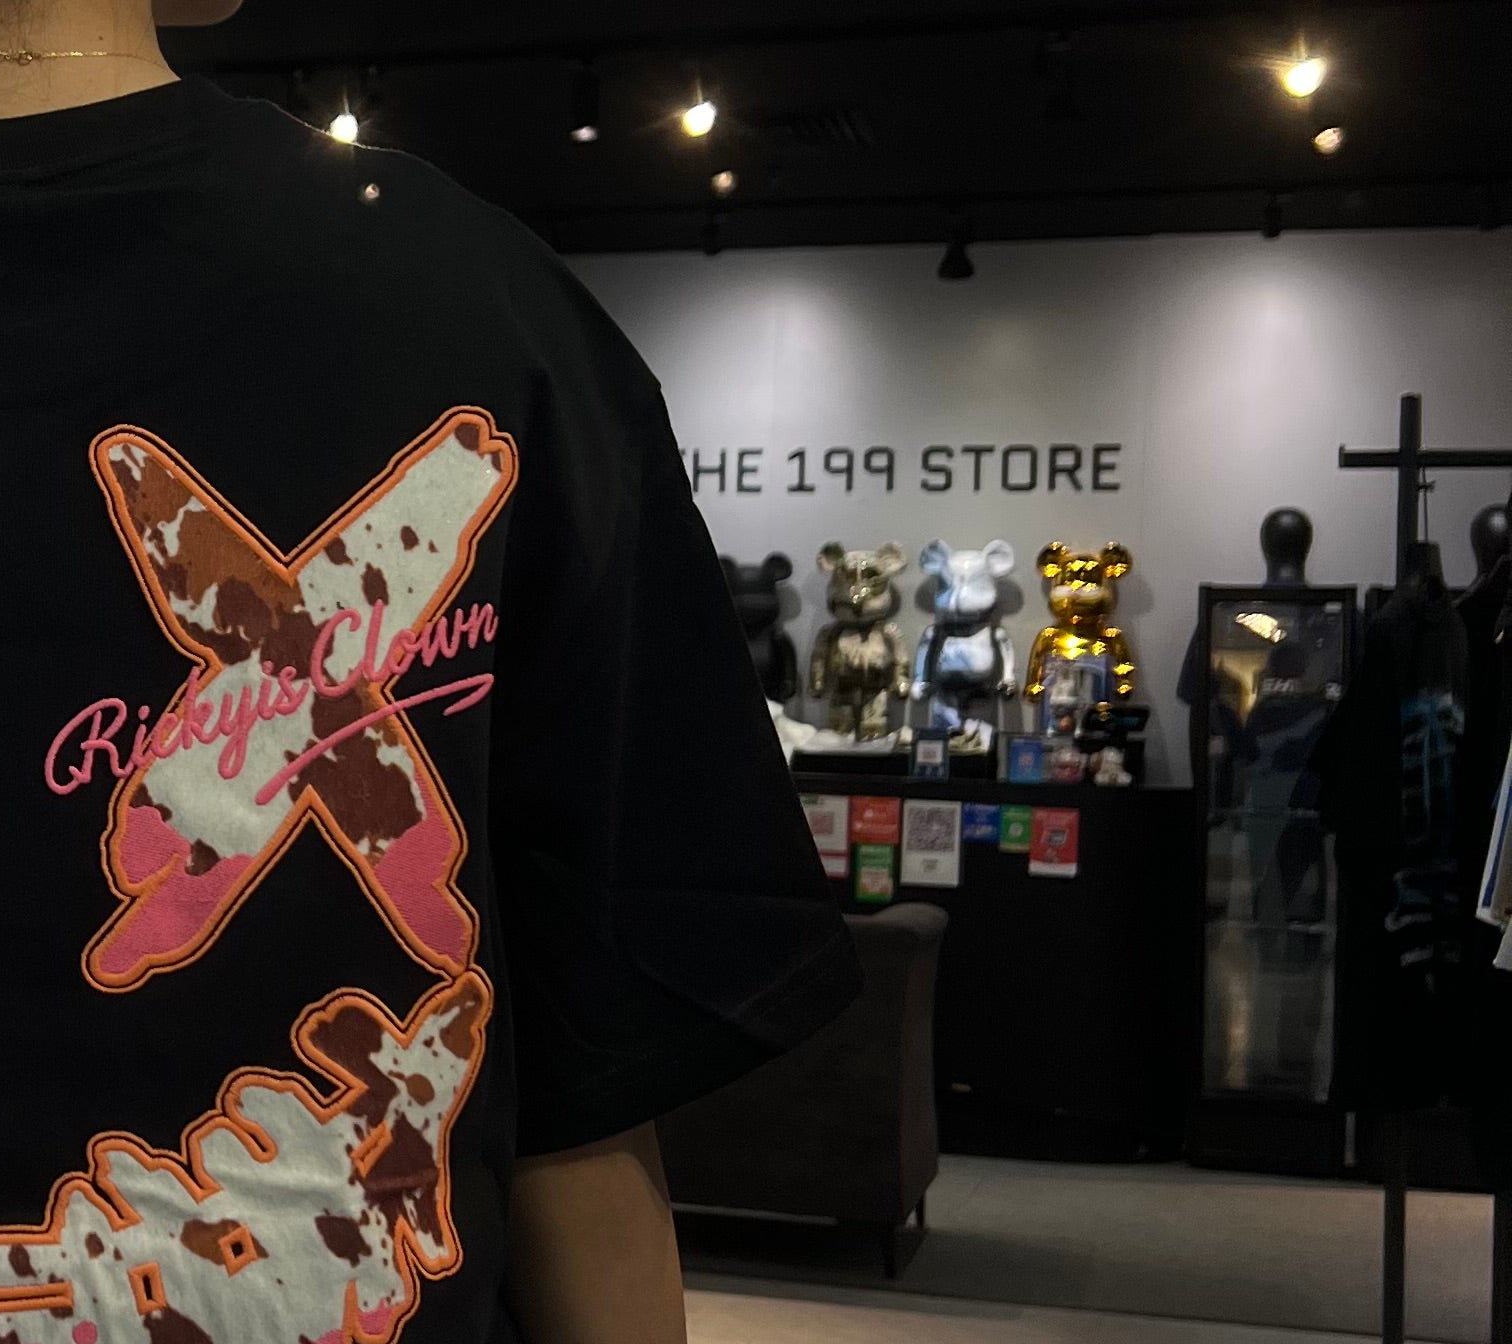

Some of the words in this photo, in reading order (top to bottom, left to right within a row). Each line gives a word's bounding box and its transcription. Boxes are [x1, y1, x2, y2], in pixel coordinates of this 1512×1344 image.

[678, 448, 763, 493] HE
[787, 445, 895, 493] 199
[920, 443, 1122, 492] STORE
